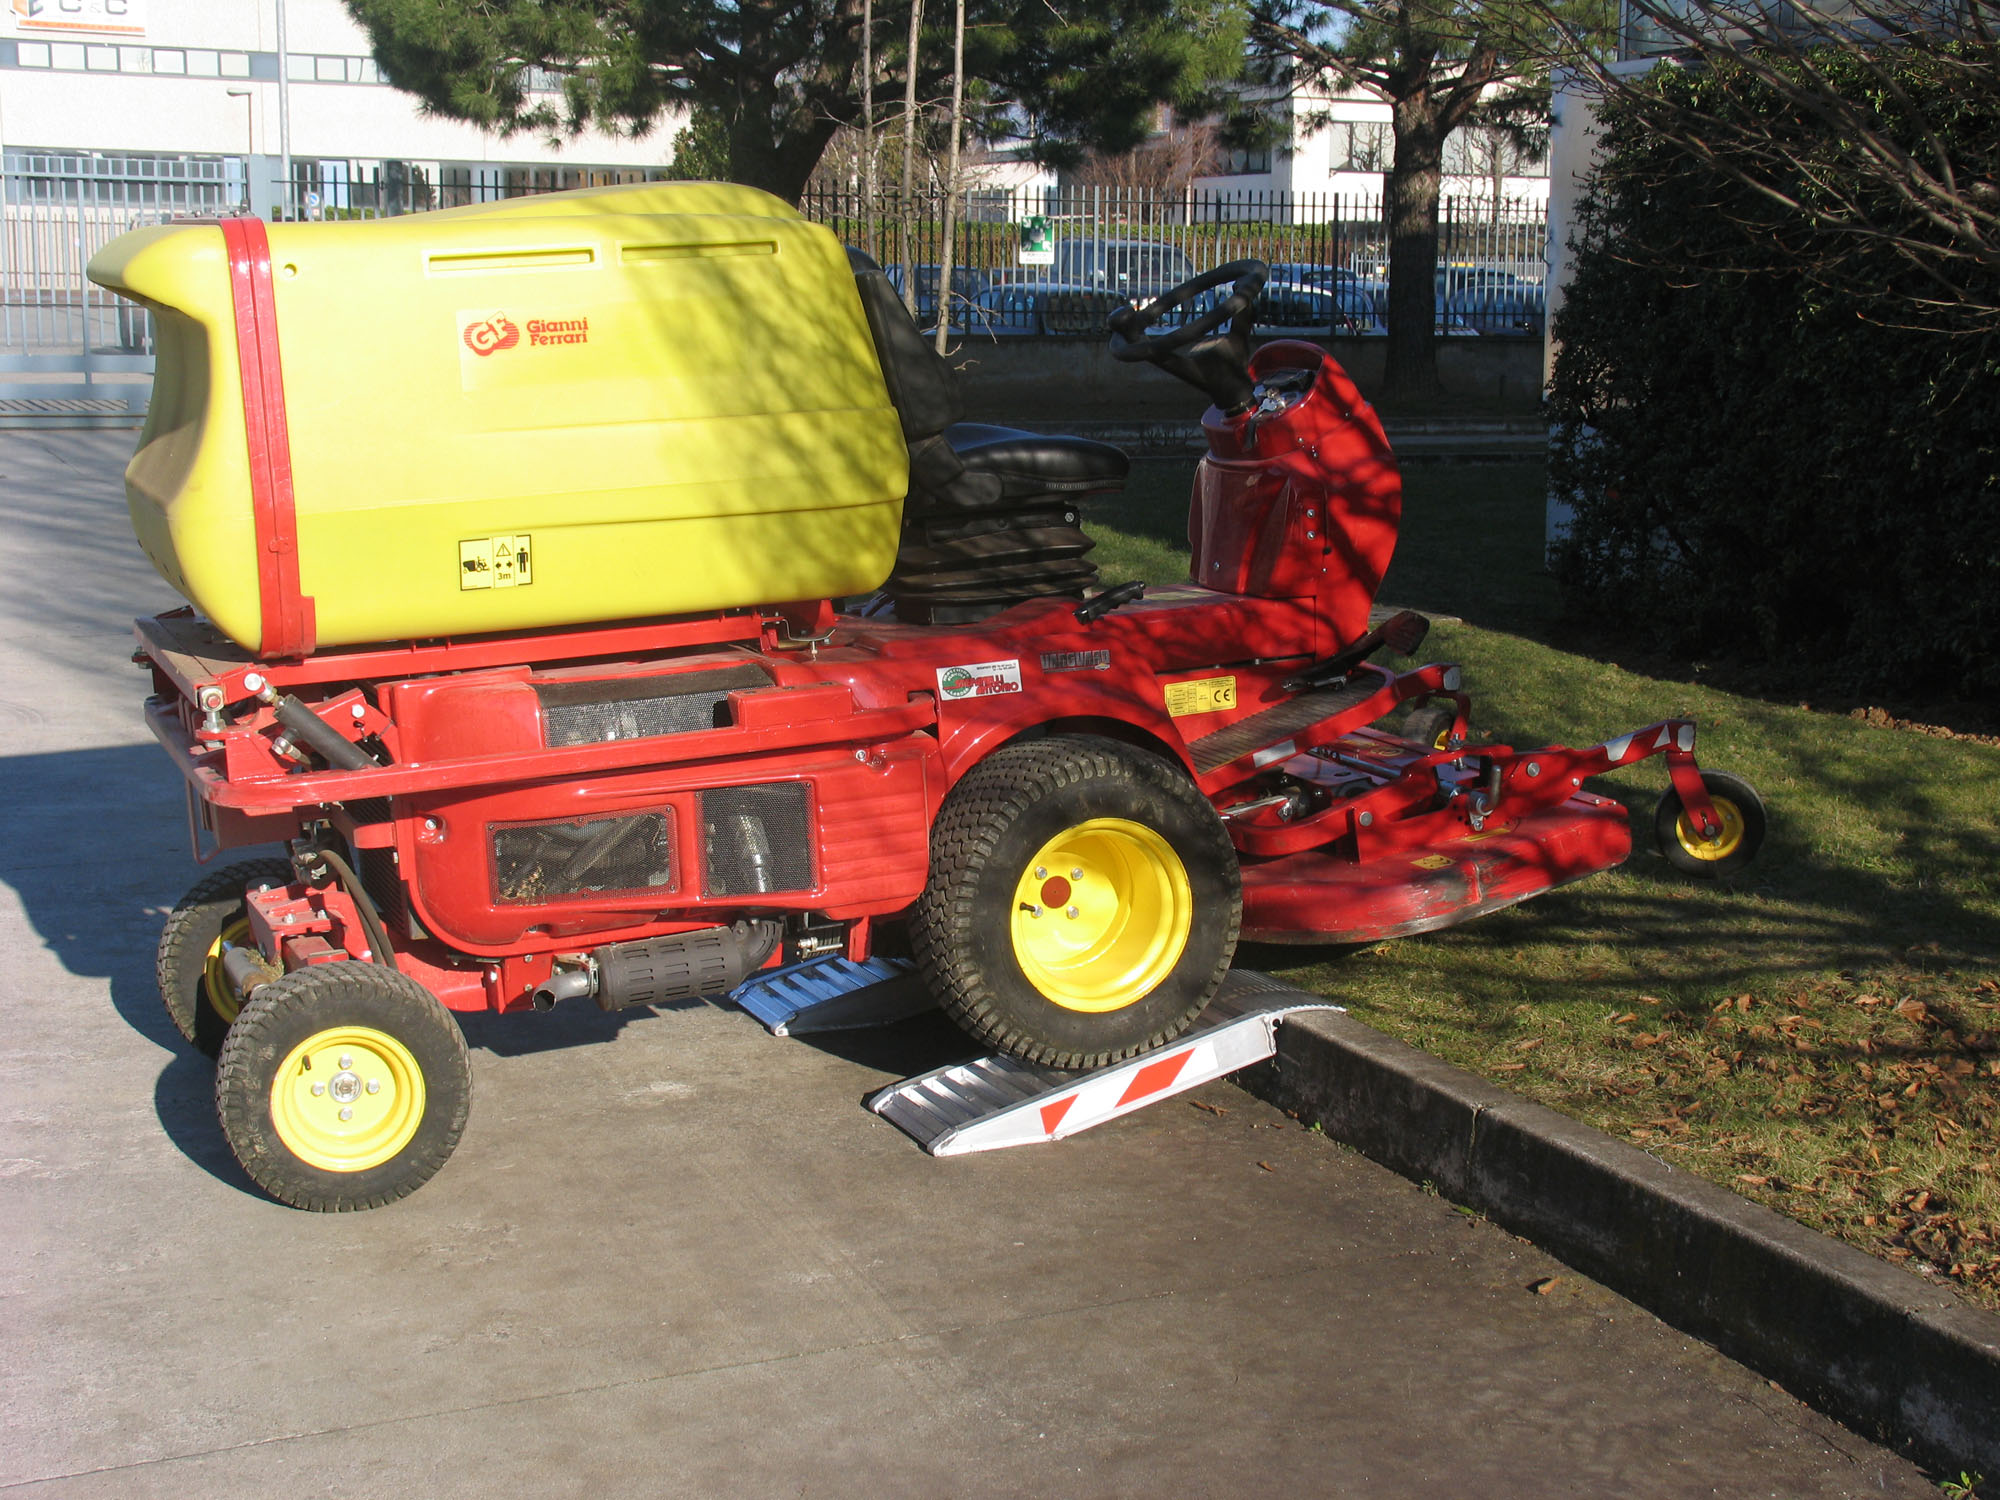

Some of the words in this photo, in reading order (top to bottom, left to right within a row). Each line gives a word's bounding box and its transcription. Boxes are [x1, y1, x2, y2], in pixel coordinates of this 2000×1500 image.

[526, 317, 589, 333] Gianni
[530, 331, 588, 346] Ferrari
[1040, 650, 1110, 669] VANGUARD
[1213, 688, 1231, 703] CE
